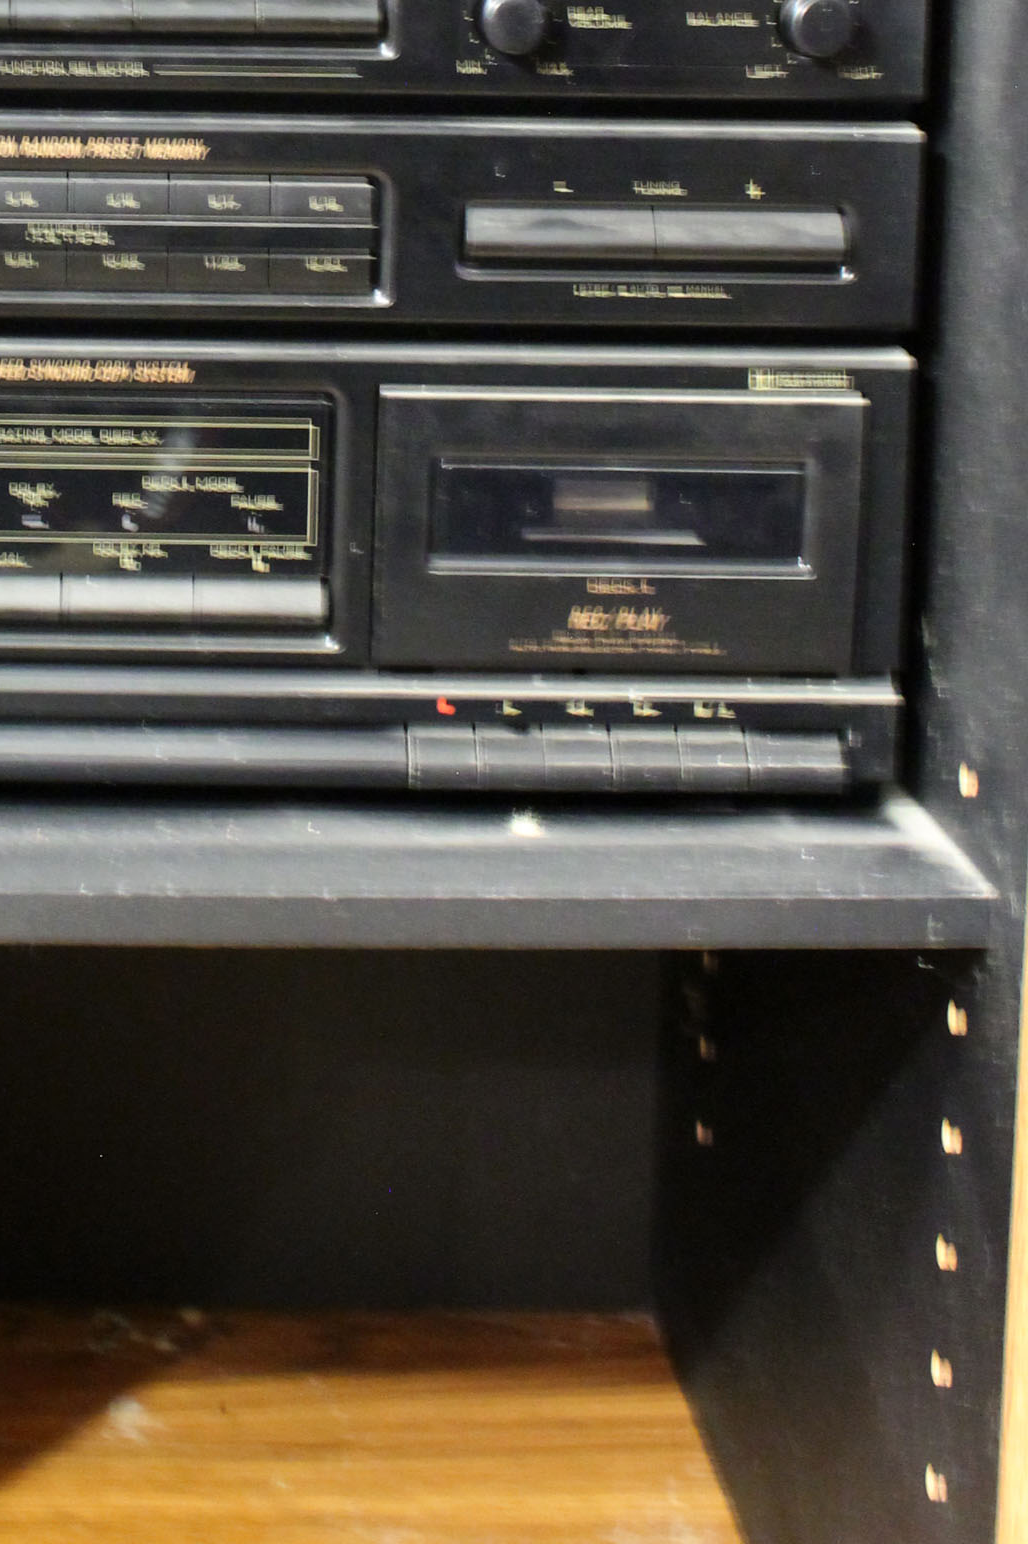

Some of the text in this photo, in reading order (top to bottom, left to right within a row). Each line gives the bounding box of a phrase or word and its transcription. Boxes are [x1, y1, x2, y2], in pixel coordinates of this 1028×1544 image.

[686, 12, 760, 27] BALANCE
[68, 60, 150, 78] SELECTOR
[456, 59, 488, 75] MIN
[746, 64, 789, 79] LEFT
[19, 135, 84, 159] RANDOM
[83, 136, 144, 160] PRESET
[143, 137, 210, 161] MEMORY
[631, 180, 689, 196] TUNING
[25, 360, 95, 383] SYNCHRO
[94, 361, 134, 383] COPY
[133, 361, 195, 384] SYSTEM
[51, 428, 100, 445] MODE
[99, 428, 165, 446] DISPLAY
[8, 482, 62, 499] DOLBY
[141, 475, 244, 493] DECK MODE
[112, 492, 148, 509] REC
[231, 494, 284, 511] PAUSE
[259, 545, 313, 560] PAUSE
